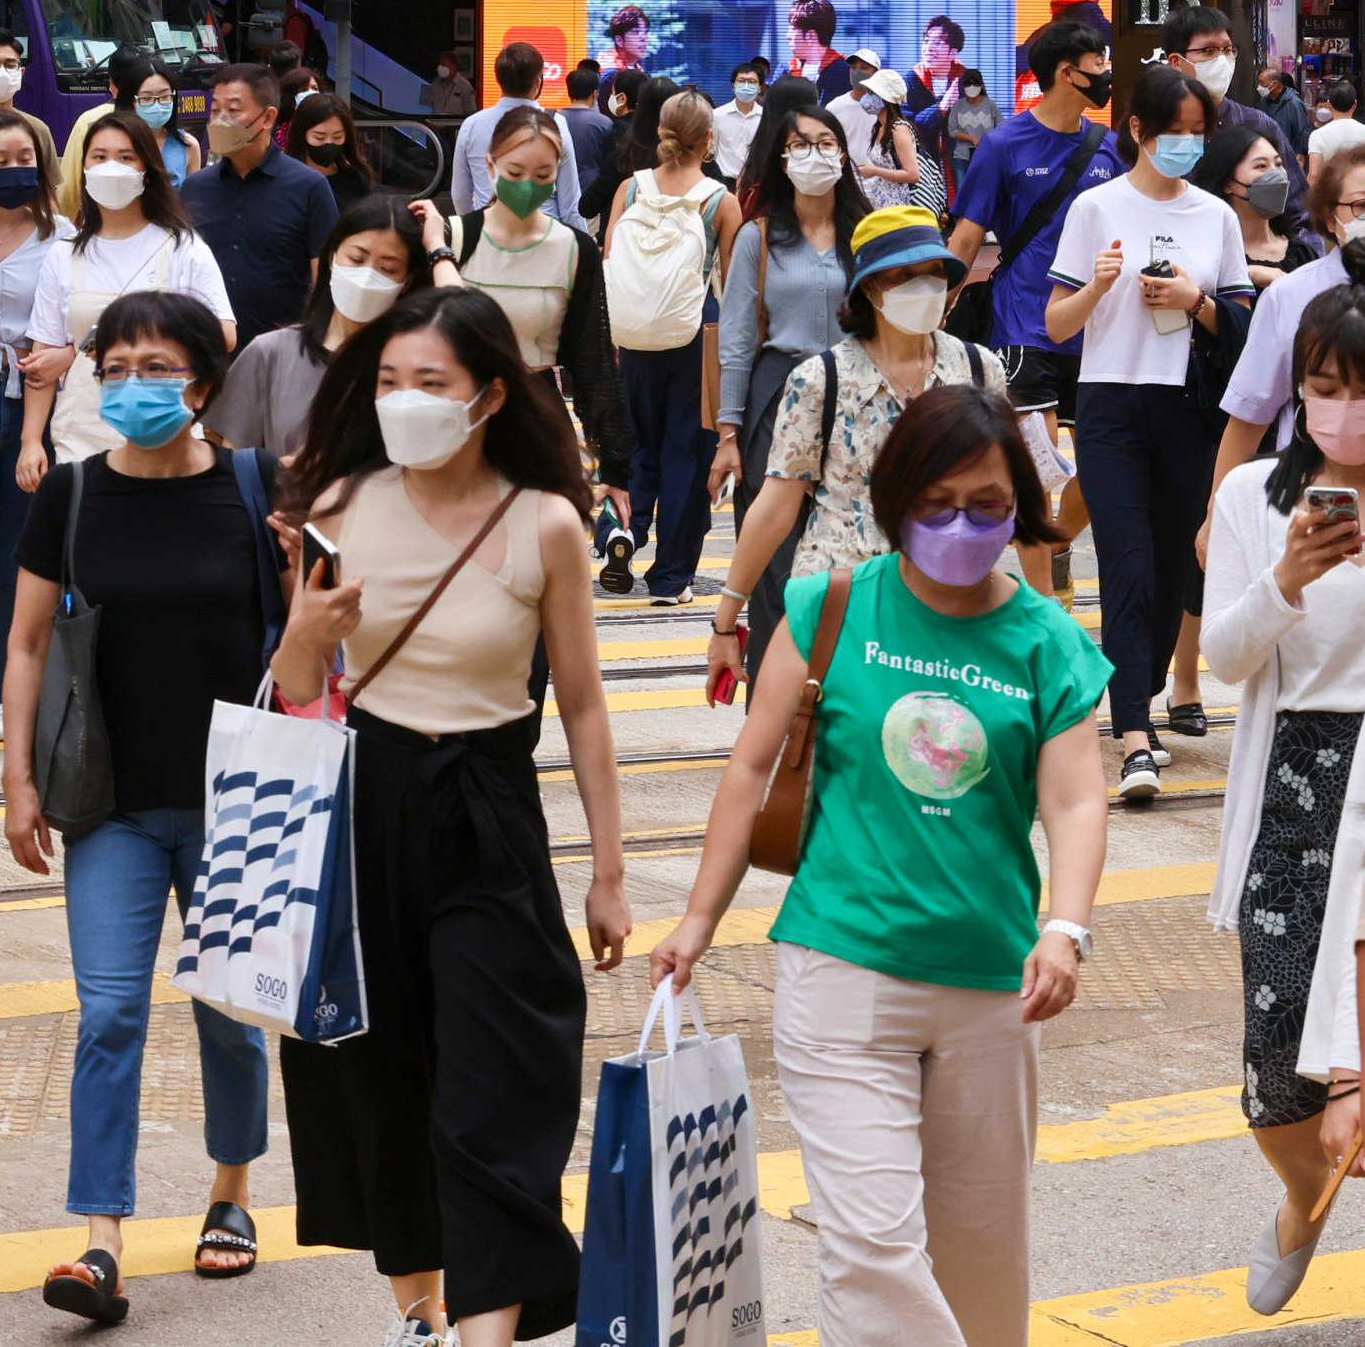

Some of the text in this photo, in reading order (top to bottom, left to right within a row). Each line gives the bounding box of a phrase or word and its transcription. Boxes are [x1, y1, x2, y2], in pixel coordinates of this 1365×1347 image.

[1155, 235, 1174, 243] FILA
[864, 641, 1028, 700] FantasticGreen
[921, 805, 951, 817] MSGM
[255, 973, 287, 999] SOGO
[731, 1300, 762, 1328] SOGO
